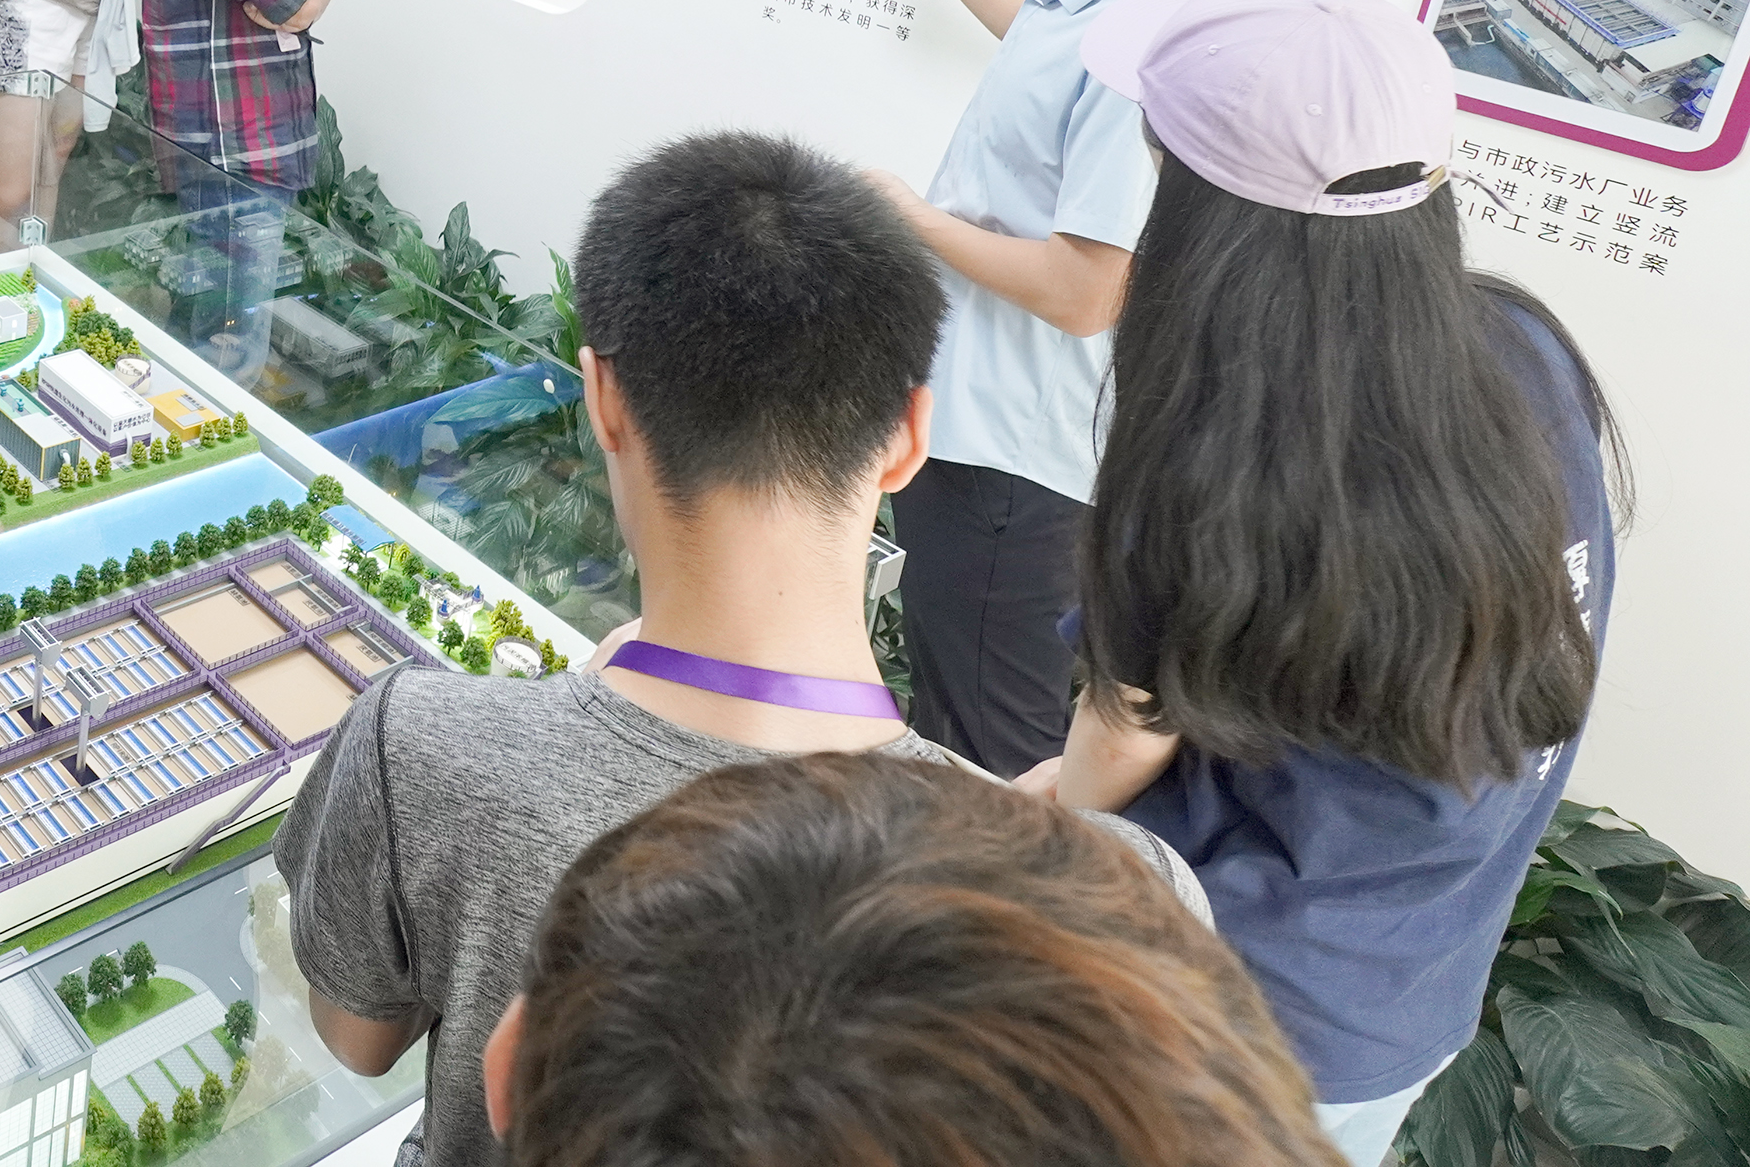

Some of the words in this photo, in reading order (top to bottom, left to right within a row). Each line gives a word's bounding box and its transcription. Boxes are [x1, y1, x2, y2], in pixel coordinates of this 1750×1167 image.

[1457, 139, 1689, 218] 与市政污水厂业务
